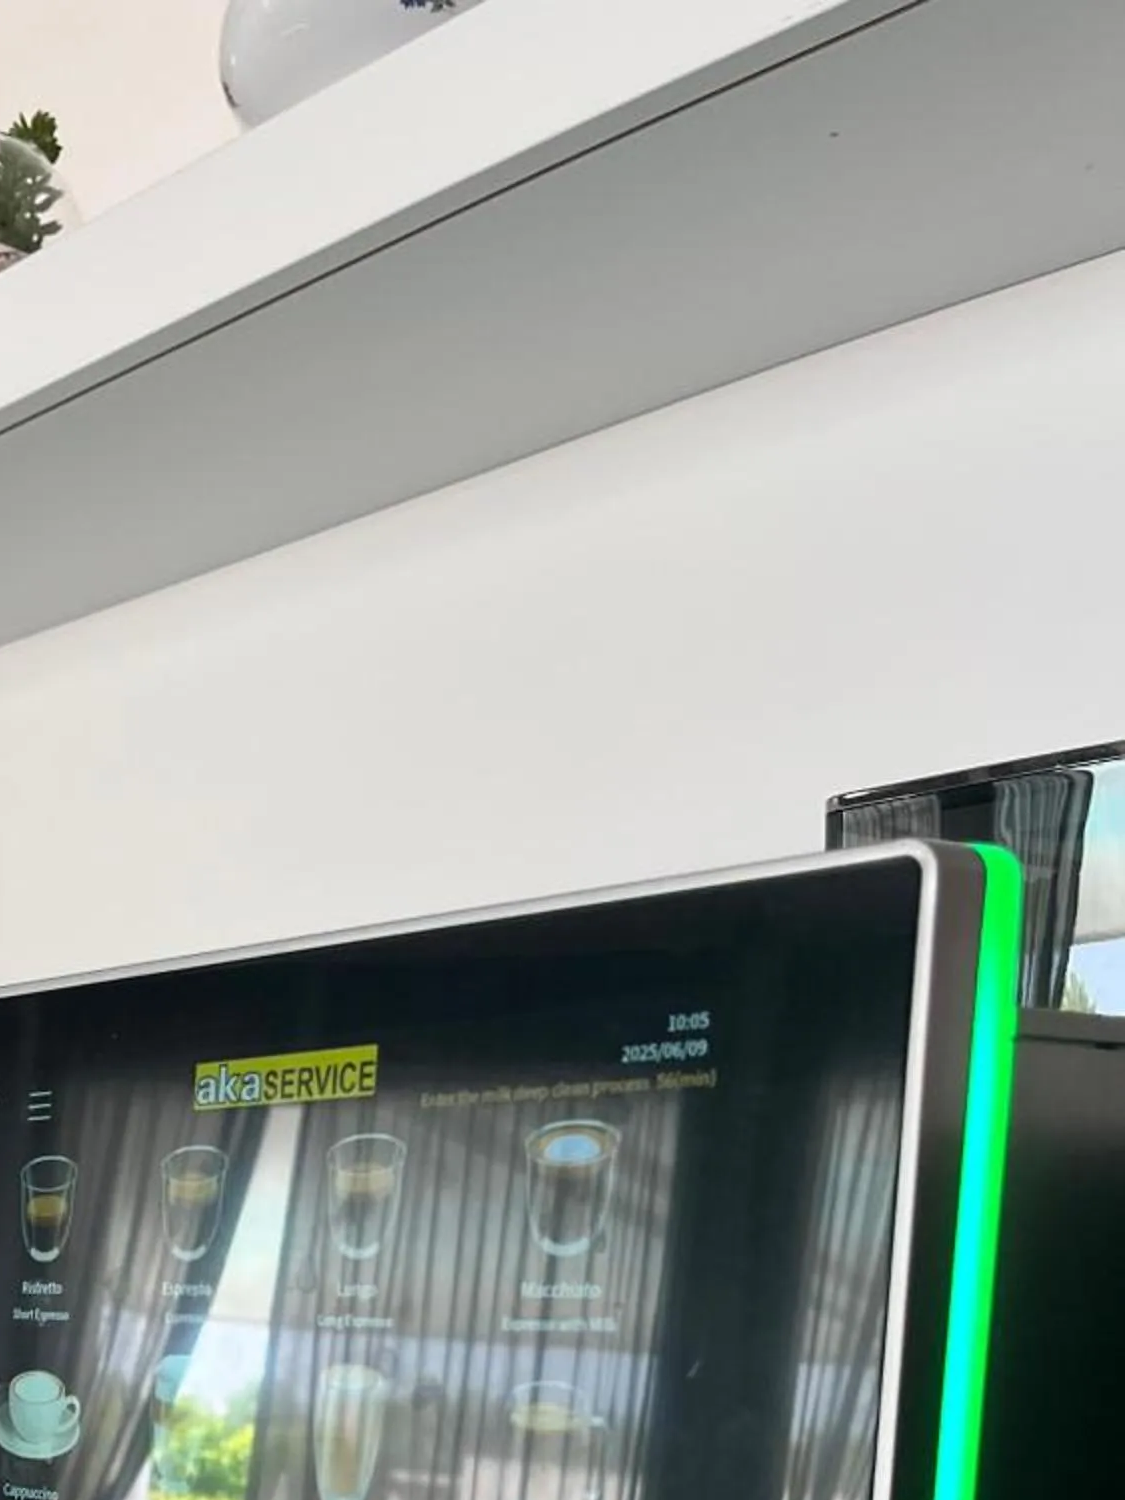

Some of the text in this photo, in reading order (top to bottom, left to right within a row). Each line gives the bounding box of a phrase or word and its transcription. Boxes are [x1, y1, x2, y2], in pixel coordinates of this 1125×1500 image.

[668, 1012, 710, 1032] 10:05
[621, 1039, 708, 1063] 2025/06/09
[22, 1281, 63, 1296] Ristretto
[520, 1281, 602, 1299] Macchiato
